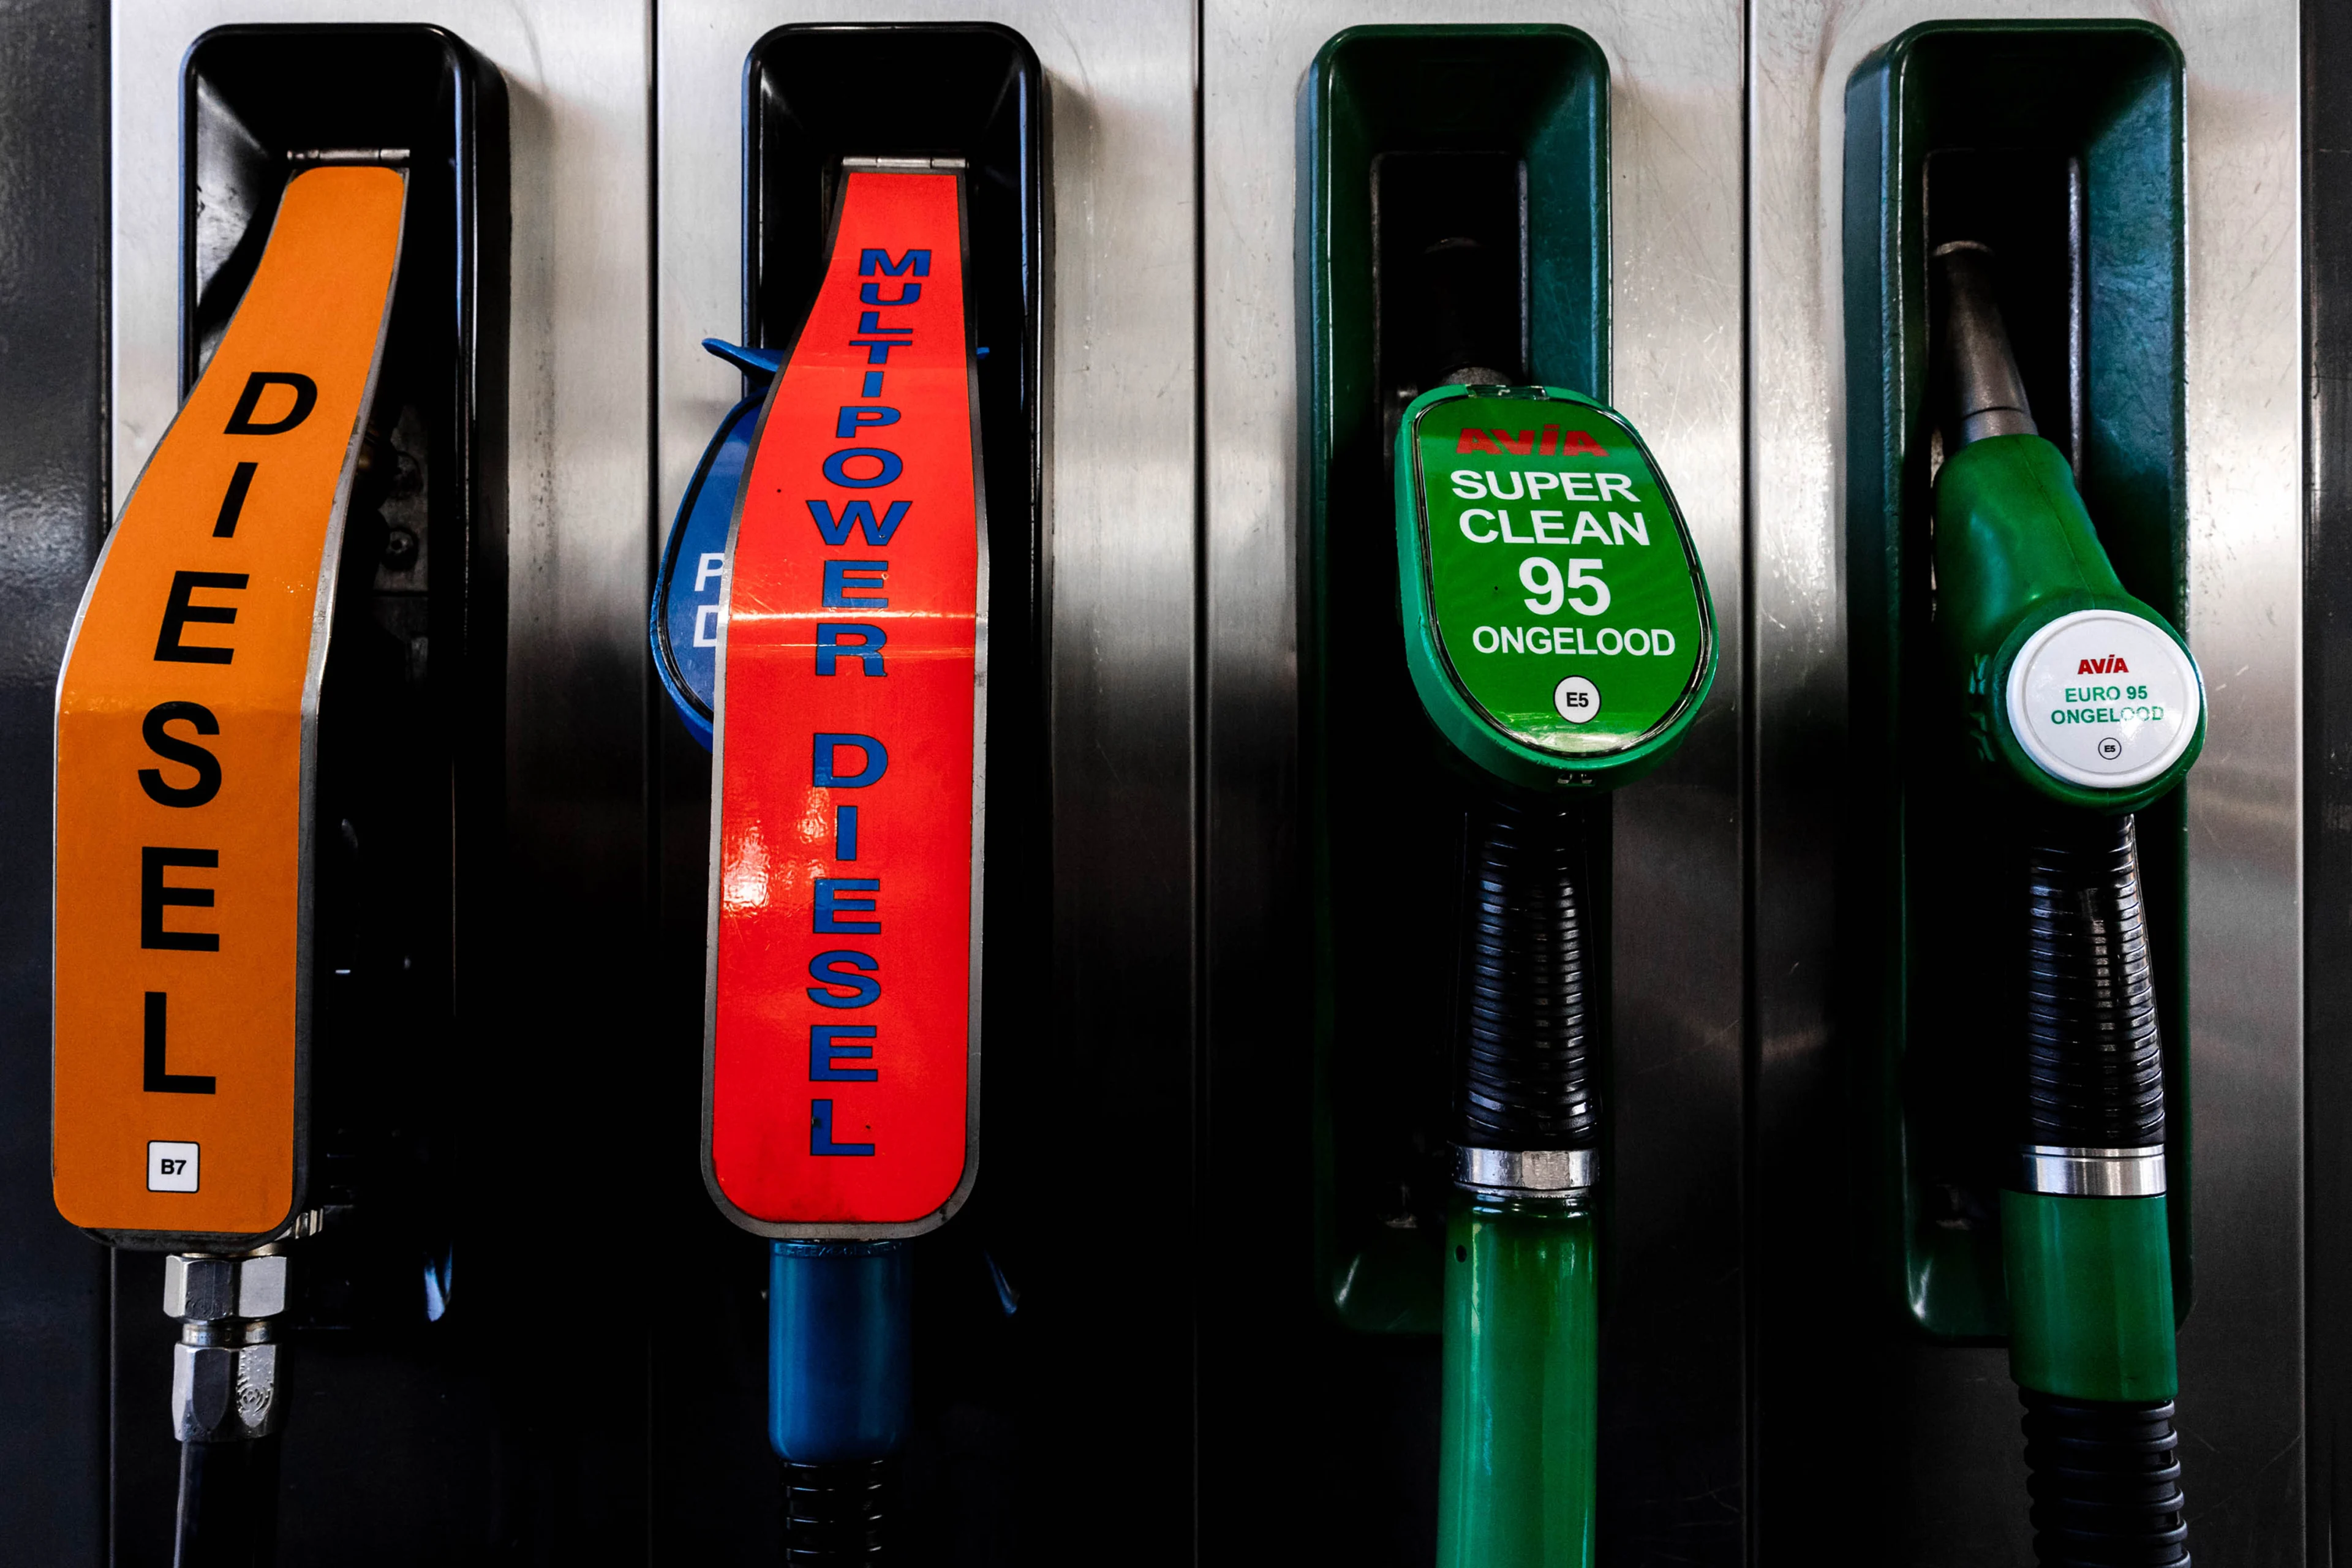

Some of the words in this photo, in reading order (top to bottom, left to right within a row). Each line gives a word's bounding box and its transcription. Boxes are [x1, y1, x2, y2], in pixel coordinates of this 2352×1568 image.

[807, 249, 932, 677] MULTIPOWER
[1450, 469, 1641, 502] SUPER
[1459, 508, 1650, 546] CLEAN
[1518, 556, 1611, 616] 95
[1472, 626, 1676, 656] ONGELOOD
[1566, 691, 1589, 708] E5
[2065, 686, 2120, 703] EURO
[2126, 685, 2149, 700] 95
[2051, 706, 2165, 725] ONGELOOD
[137, 371, 318, 1096] DIESEL
[807, 733, 889, 1156] DIESEL
[160, 1158, 187, 1175] B7
